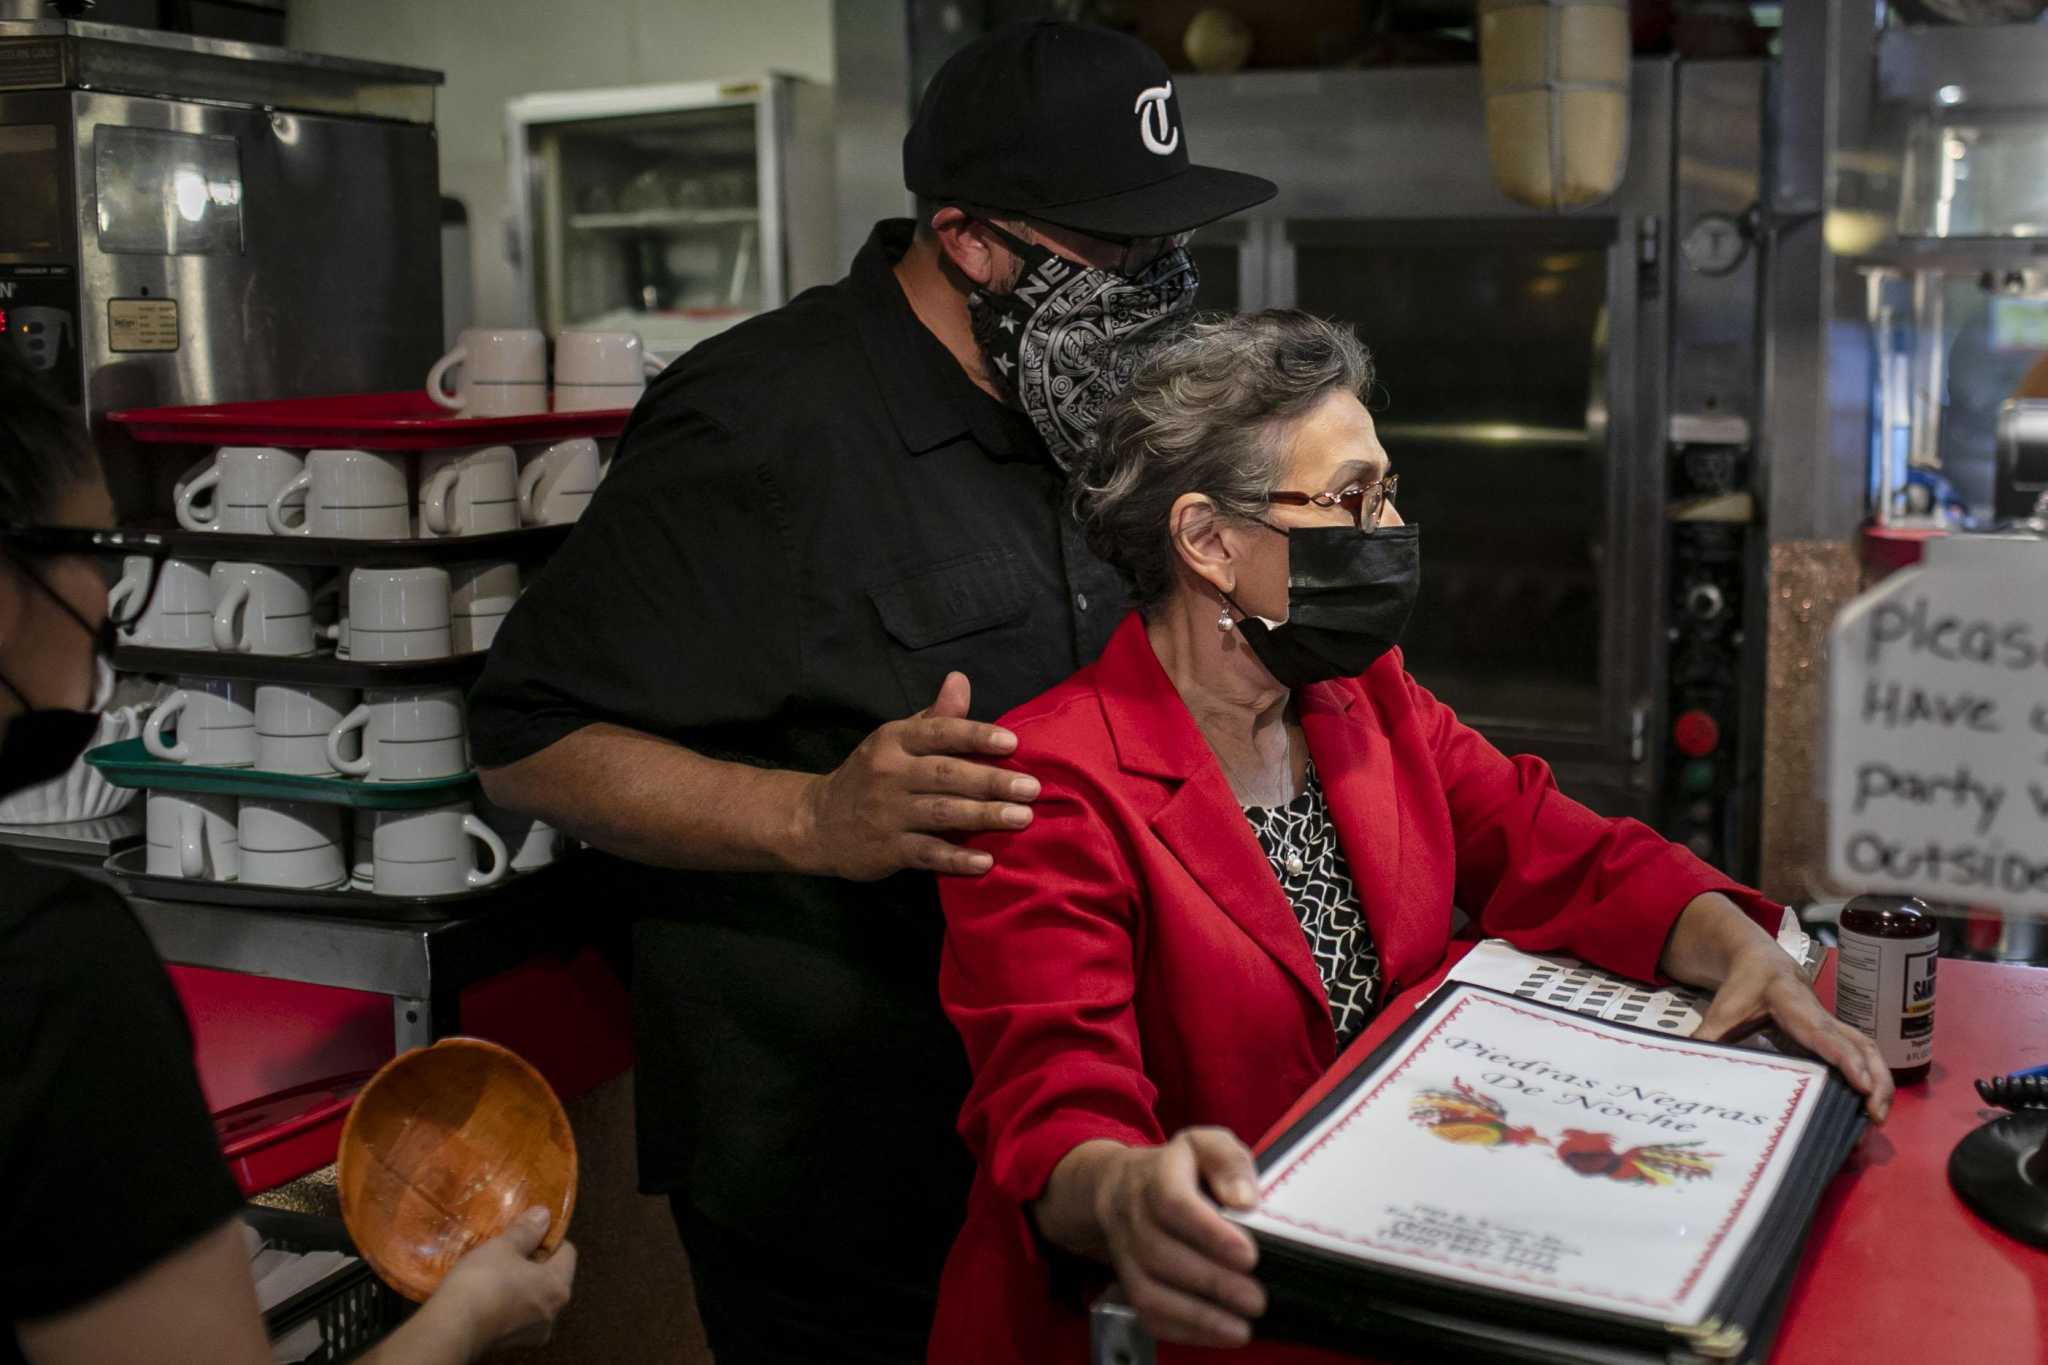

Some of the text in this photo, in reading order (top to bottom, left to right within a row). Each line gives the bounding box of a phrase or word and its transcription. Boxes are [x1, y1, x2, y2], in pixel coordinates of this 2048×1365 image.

[1444, 1036, 1769, 1127] Piedras Negras
[1481, 1072, 1698, 1133] De Noche
